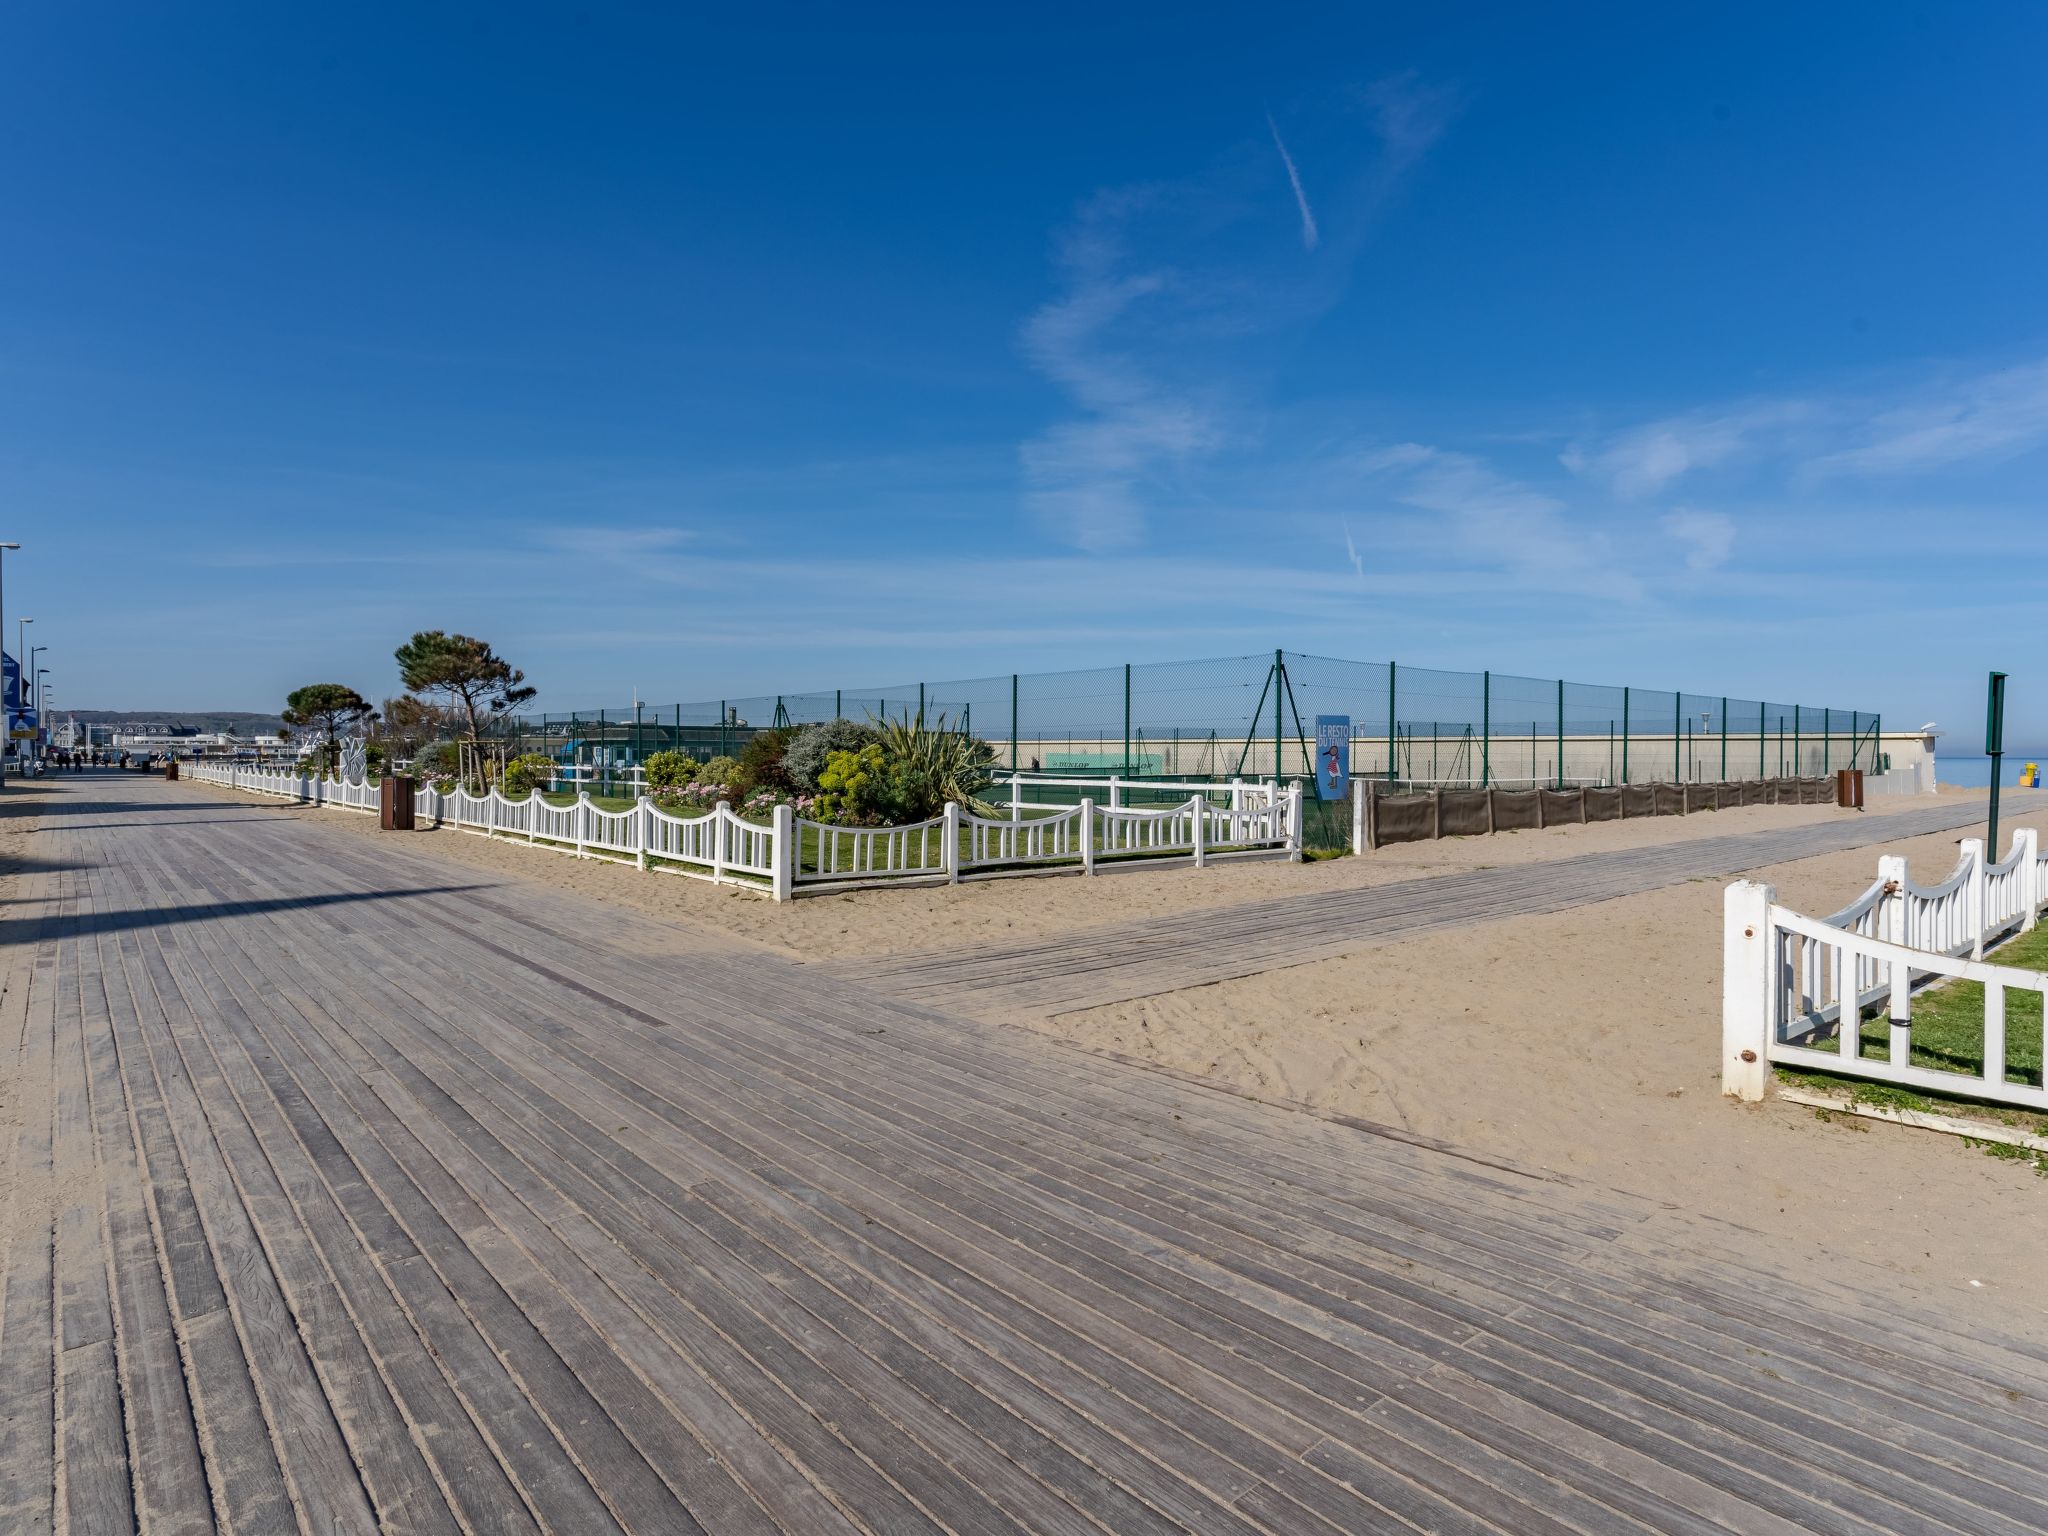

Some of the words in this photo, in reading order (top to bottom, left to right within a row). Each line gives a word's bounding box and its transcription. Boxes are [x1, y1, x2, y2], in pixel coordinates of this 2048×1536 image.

[1318, 725, 1327, 738] LE
[1328, 724, 1349, 738] RESTO
[1318, 738, 1327, 747] DU
[1328, 738, 1349, 747] TENNIS
